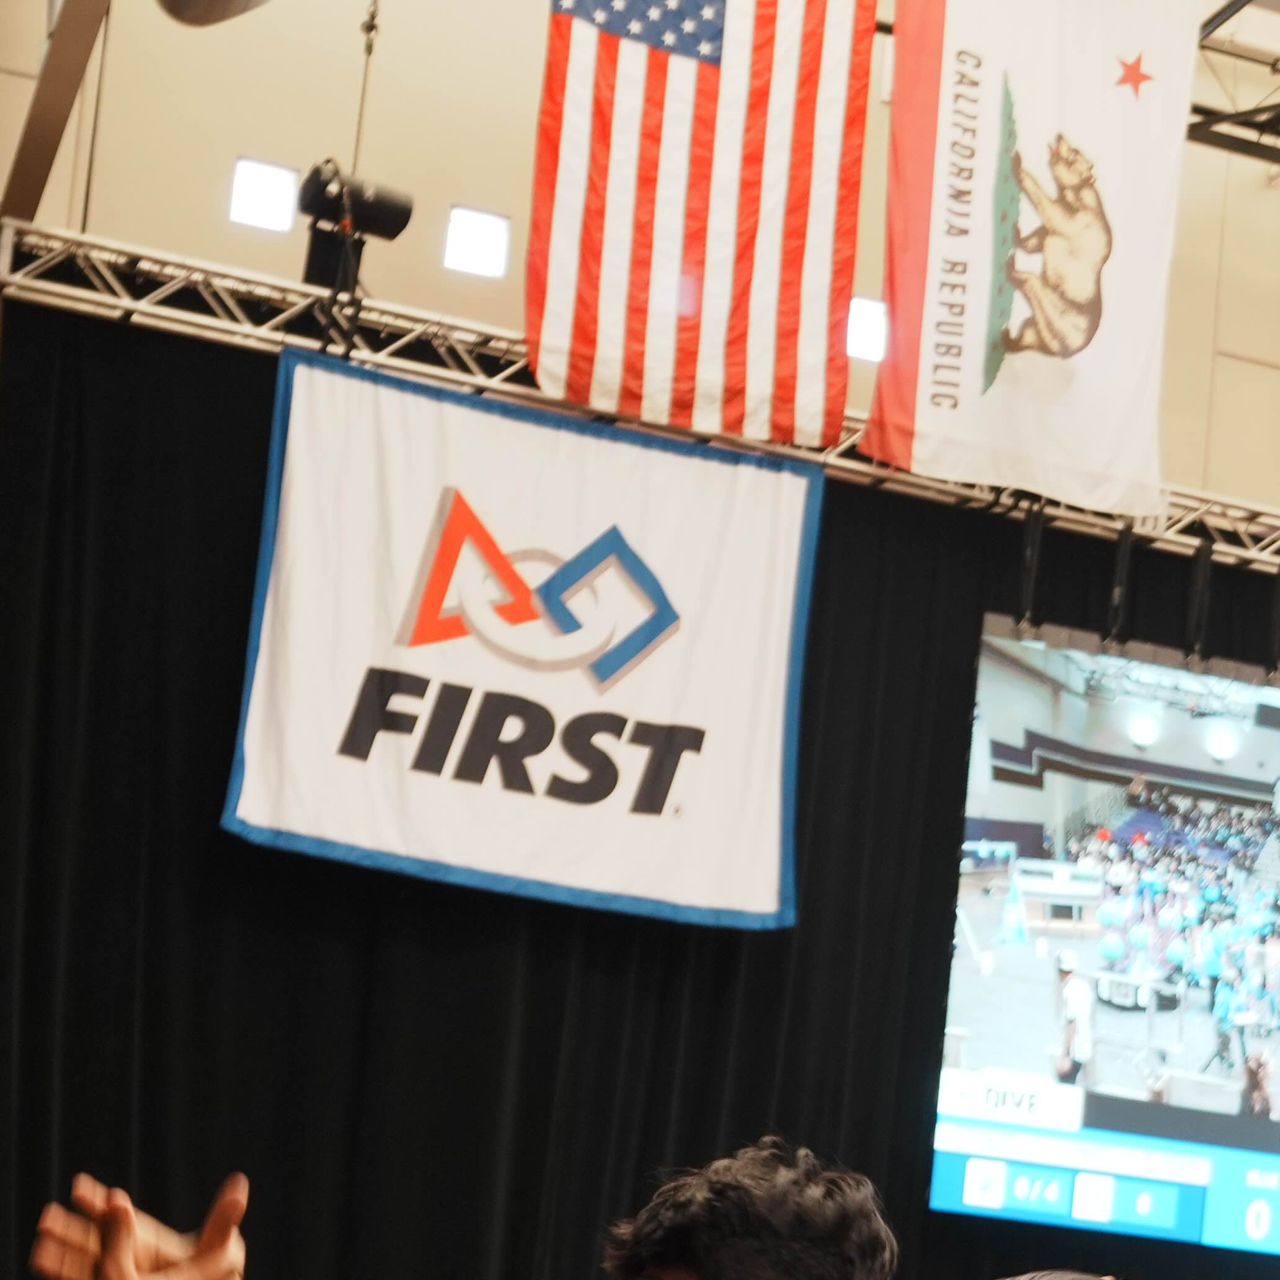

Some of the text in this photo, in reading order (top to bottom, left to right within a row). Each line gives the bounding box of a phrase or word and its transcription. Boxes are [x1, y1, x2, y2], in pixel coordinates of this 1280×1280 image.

[930, 50, 982, 411] CALIFORNIA REPUBLIC
[336, 667, 705, 816] FIRST
[1245, 1200, 1271, 1240] 0
